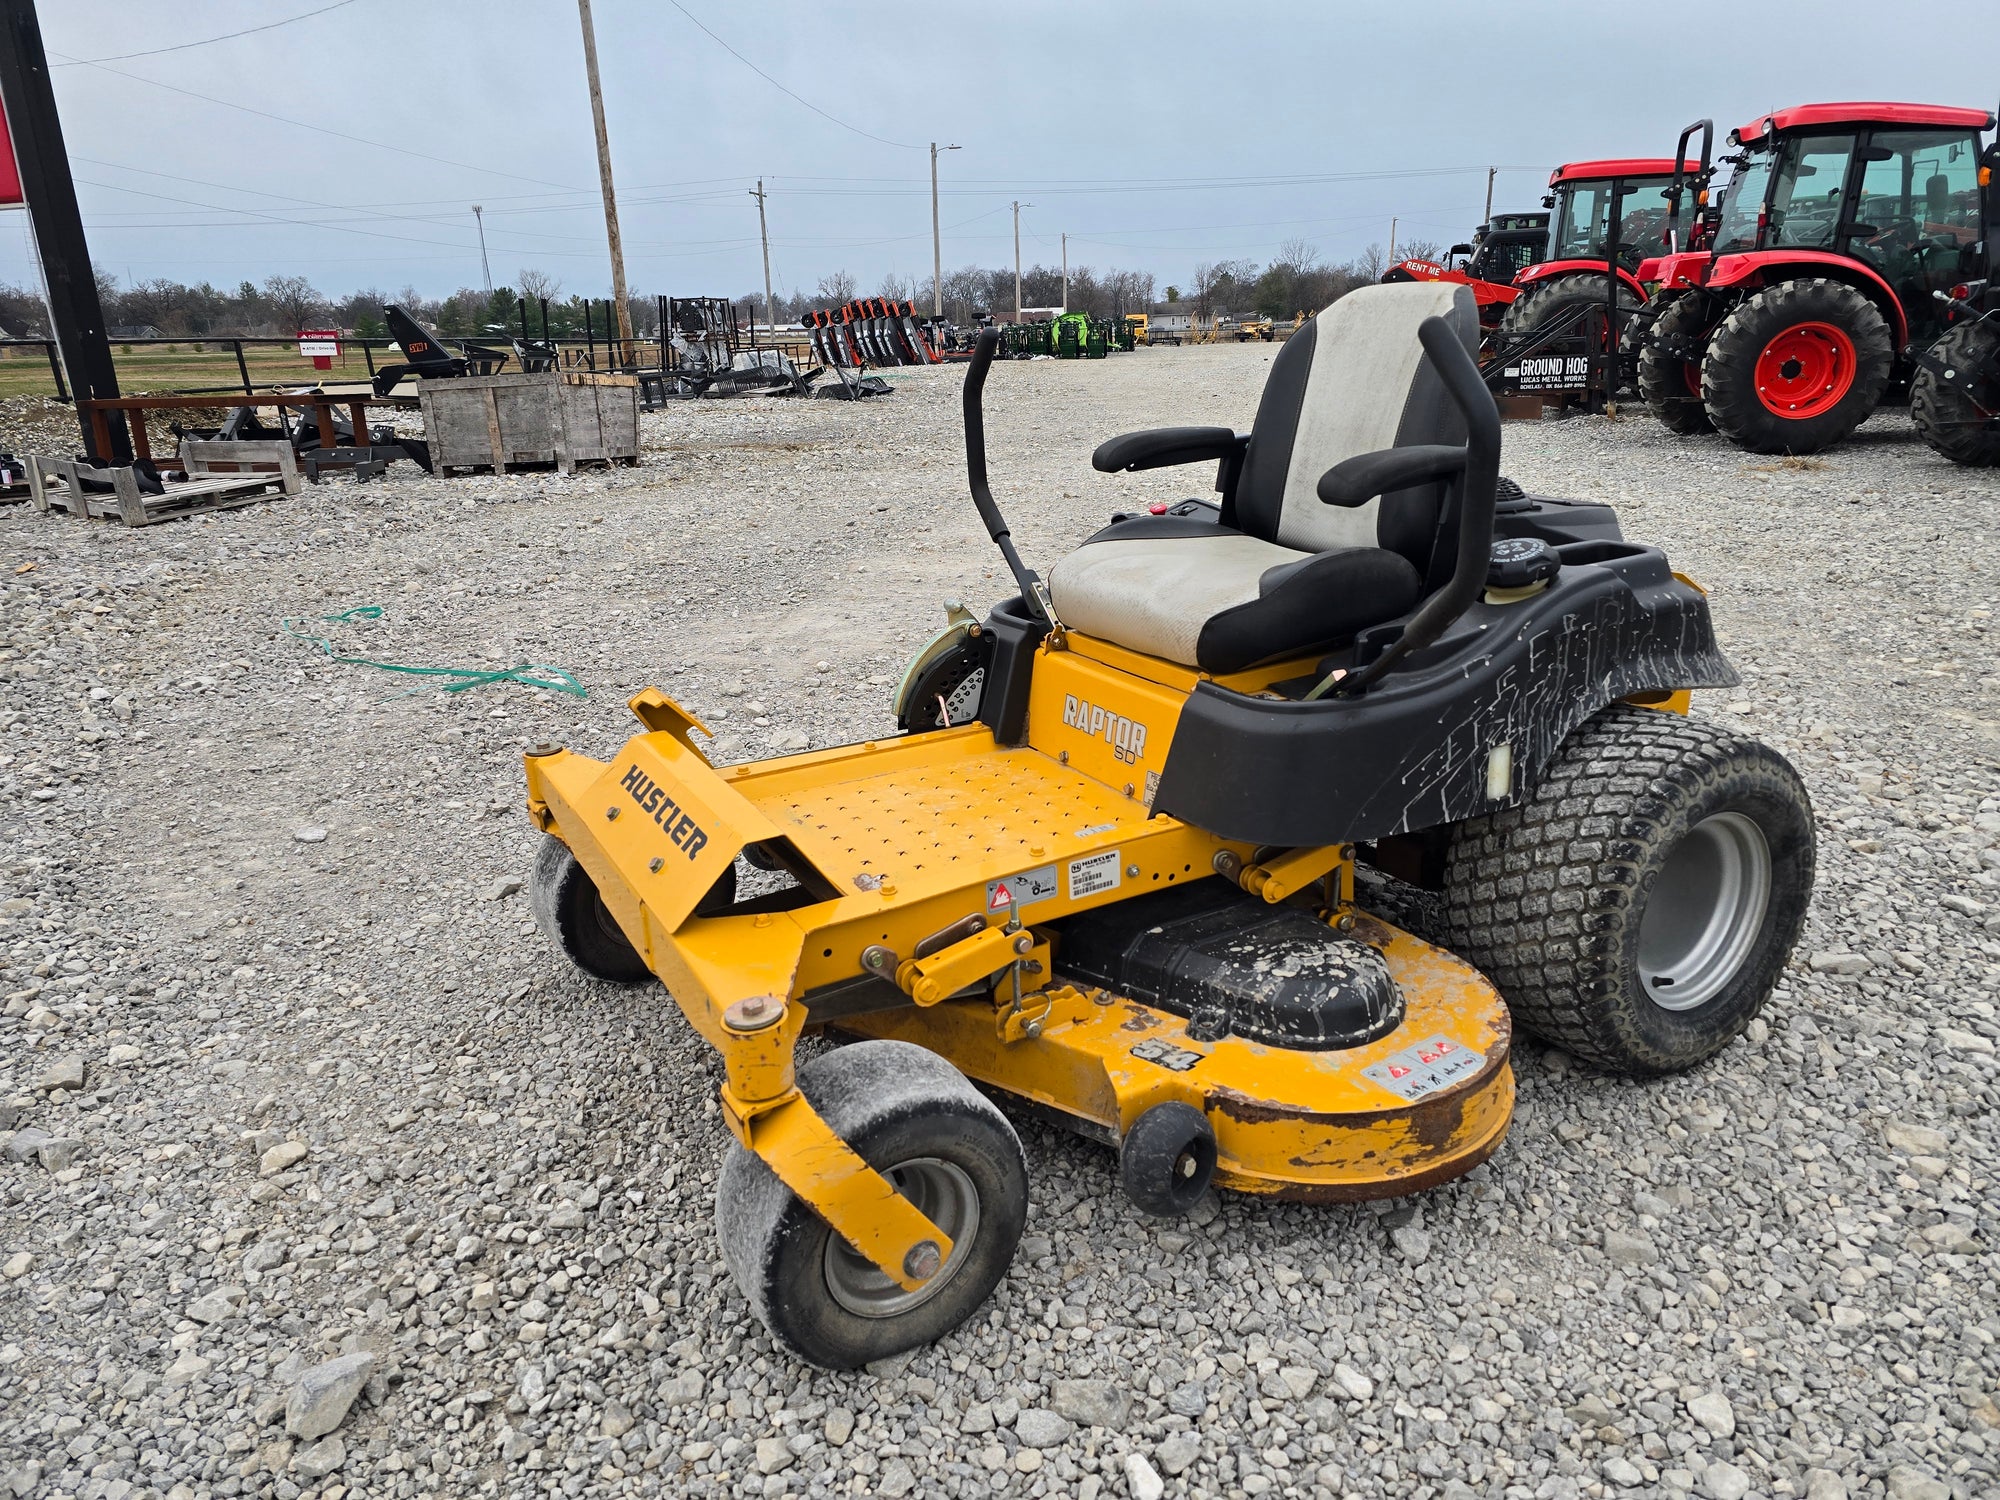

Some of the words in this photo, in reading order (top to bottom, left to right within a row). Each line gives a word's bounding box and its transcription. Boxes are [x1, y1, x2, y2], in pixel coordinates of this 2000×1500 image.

[1406, 261, 1428, 273] RENT
[1428, 266, 1441, 276] ME
[1520, 358, 1563, 376] GROUND
[1566, 357, 1589, 374] HOG
[1063, 693, 1148, 759] RAPTOR
[1114, 745, 1136, 765] SD
[620, 763, 709, 861] HUSTLER
[1081, 853, 1116, 867] HUSTLER
